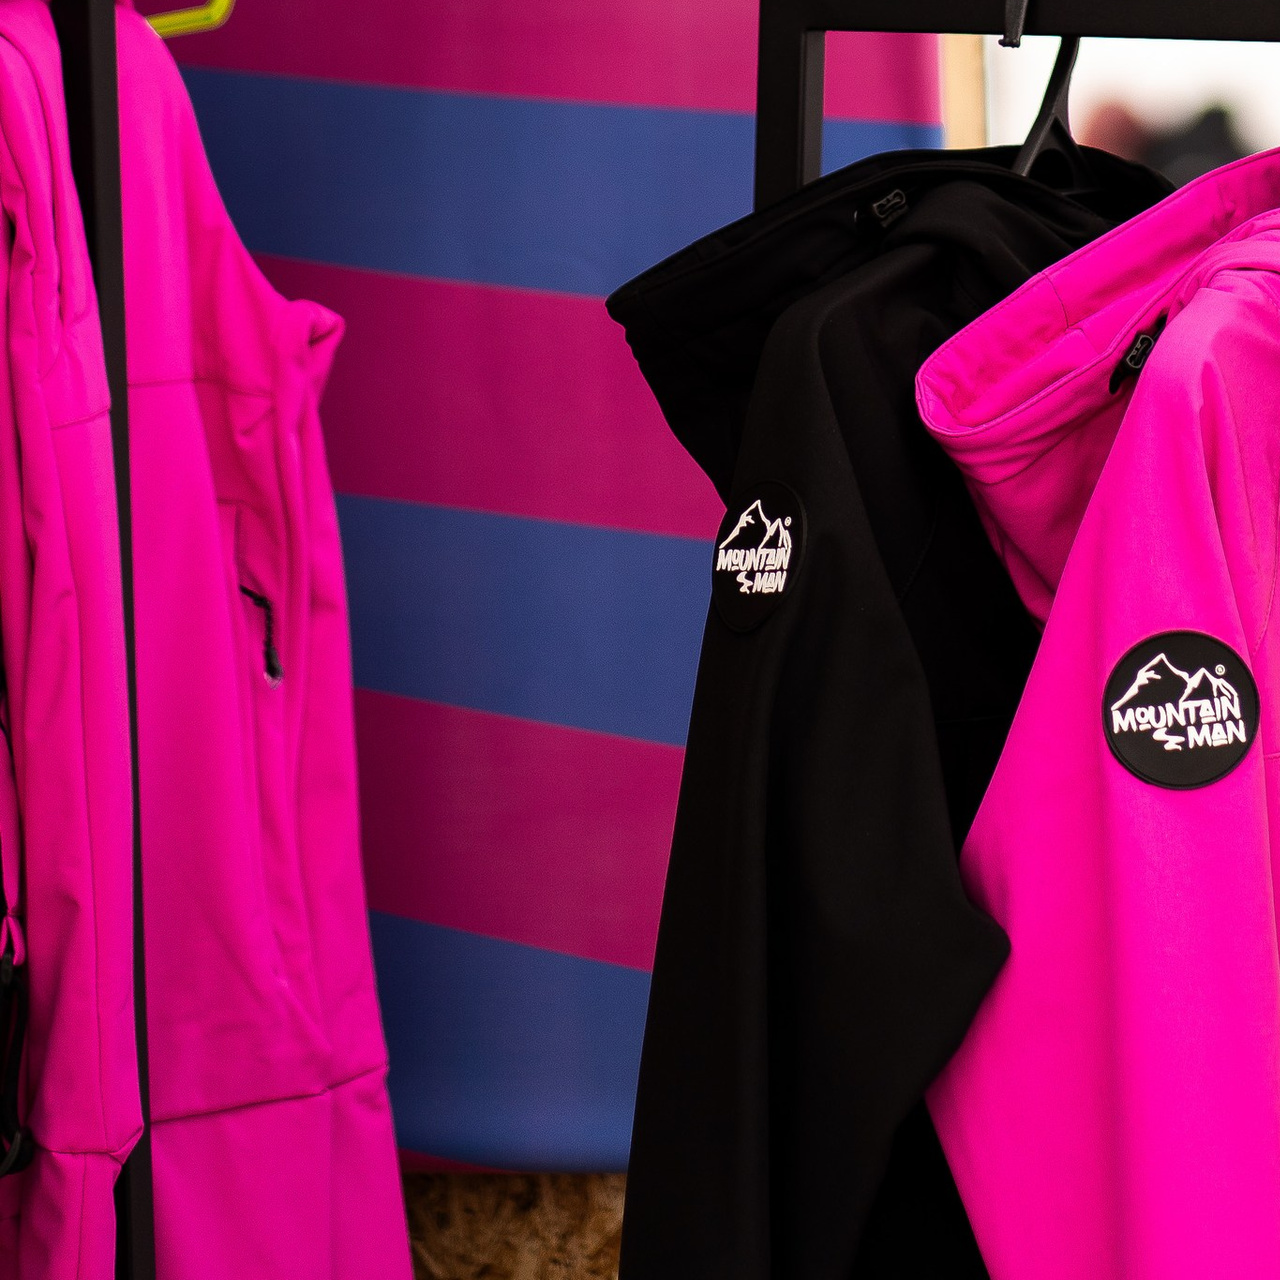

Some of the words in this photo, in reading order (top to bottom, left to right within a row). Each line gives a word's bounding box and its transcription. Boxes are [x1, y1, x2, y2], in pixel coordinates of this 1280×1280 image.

[716, 546, 792, 571] MOUNTAIN
[752, 571, 787, 593] MAN
[1111, 695, 1242, 734] MOUNTAIN
[1187, 719, 1247, 749] MAN
